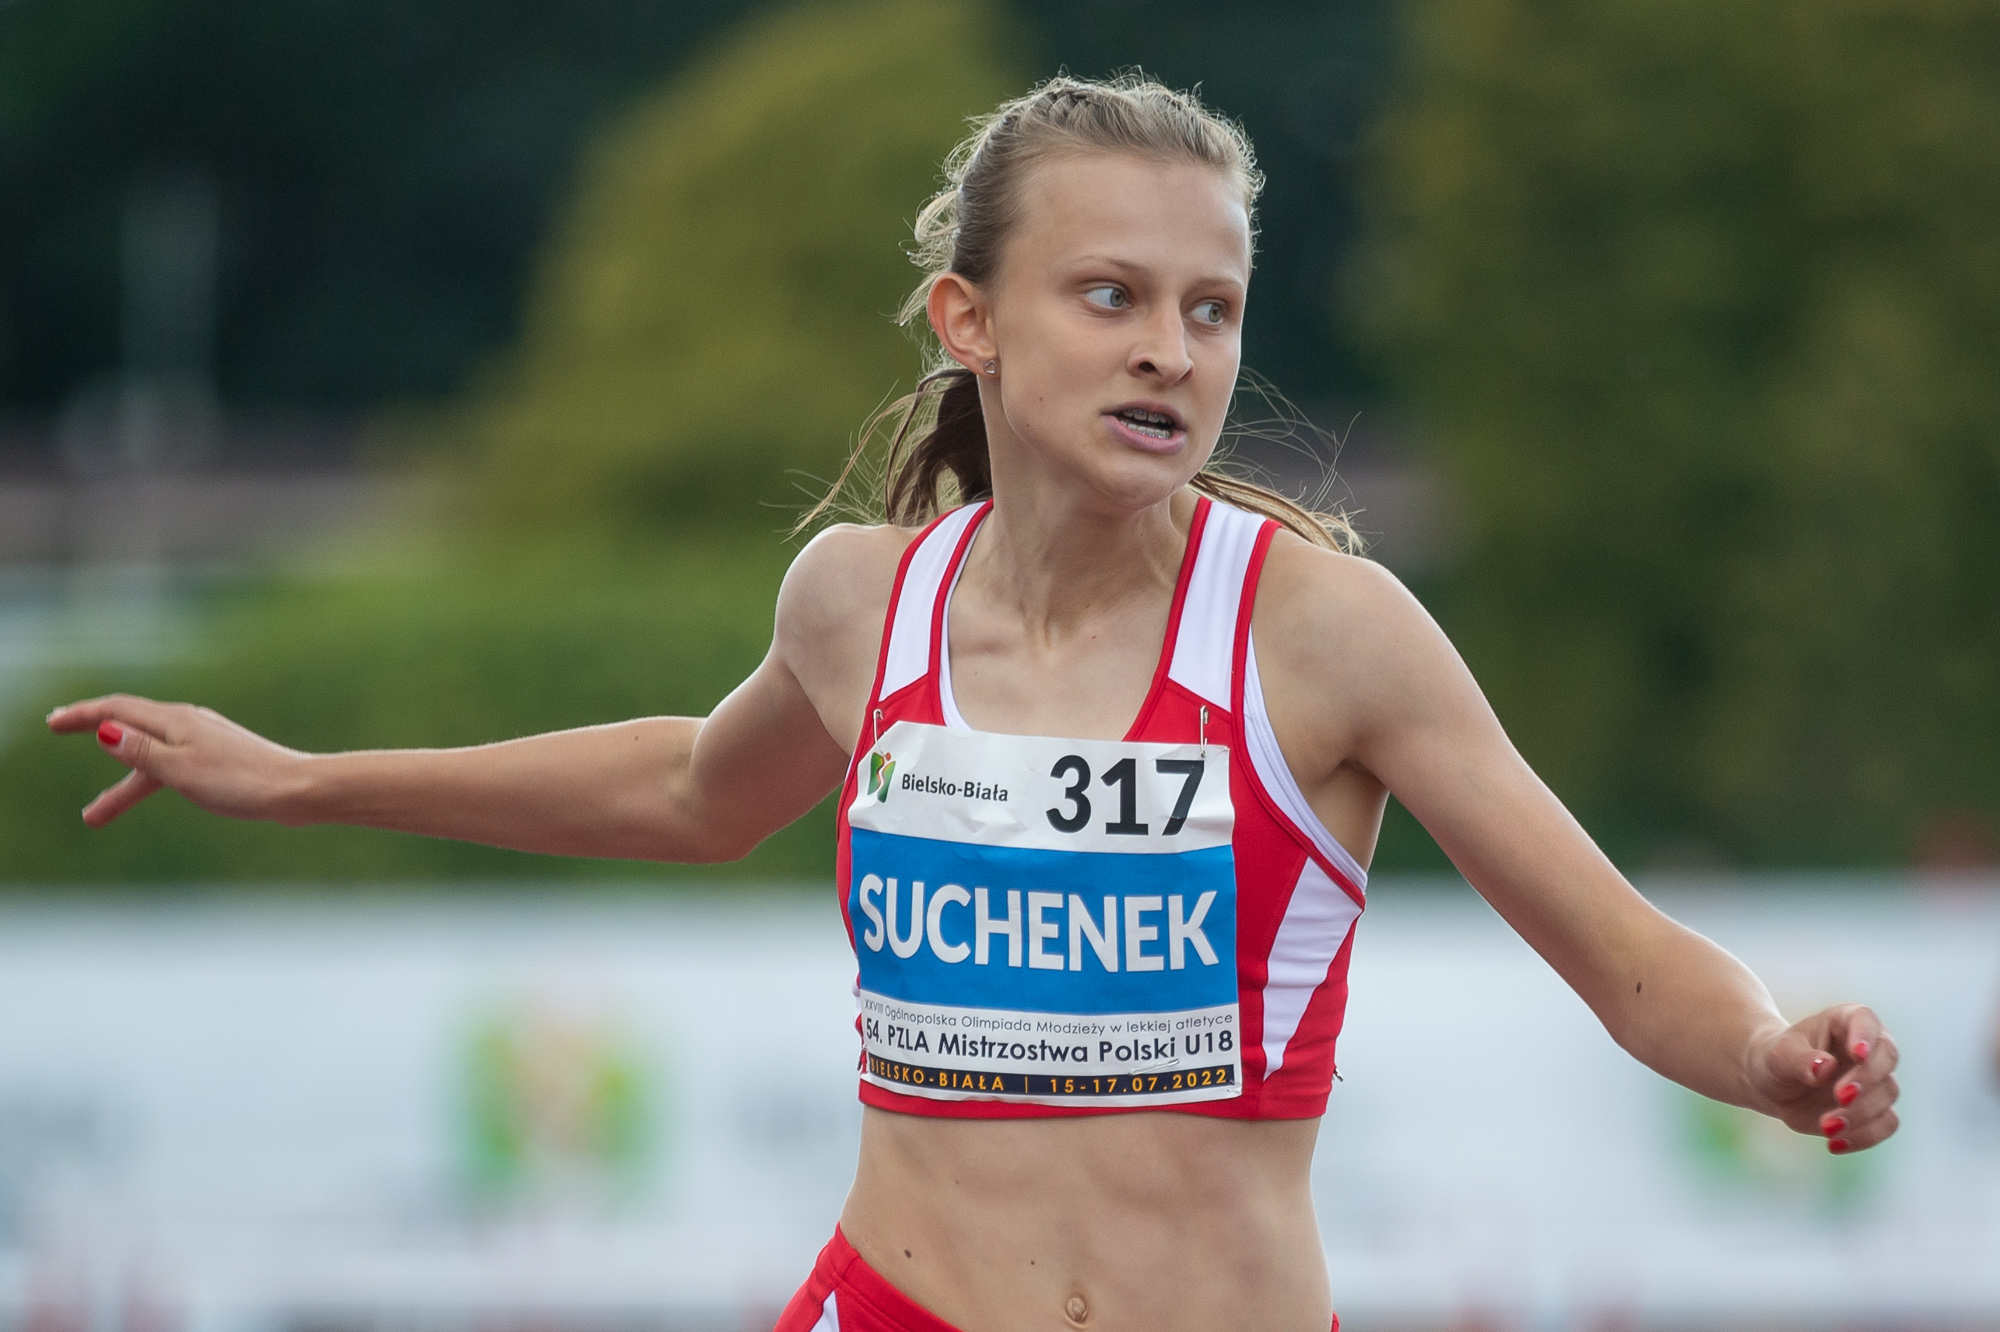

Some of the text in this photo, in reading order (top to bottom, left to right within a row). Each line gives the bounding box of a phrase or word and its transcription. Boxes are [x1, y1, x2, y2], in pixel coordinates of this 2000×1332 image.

[901, 774, 1008, 802] Bielsko-Biała
[1045, 754, 1205, 836] 317
[859, 873, 1220, 973] SUCHENEK
[864, 999, 1233, 1036] XXVIII Ogólnopolska Olimpiada Młodzieży w lekkiej atletyce
[866, 1017, 1233, 1063] 54. PZLA Mistrzostwa Polski U18
[870, 1057, 1004, 1091] BIELSKO-BIAŁA
[1050, 1068, 1227, 1094] 15-17.07.2022
